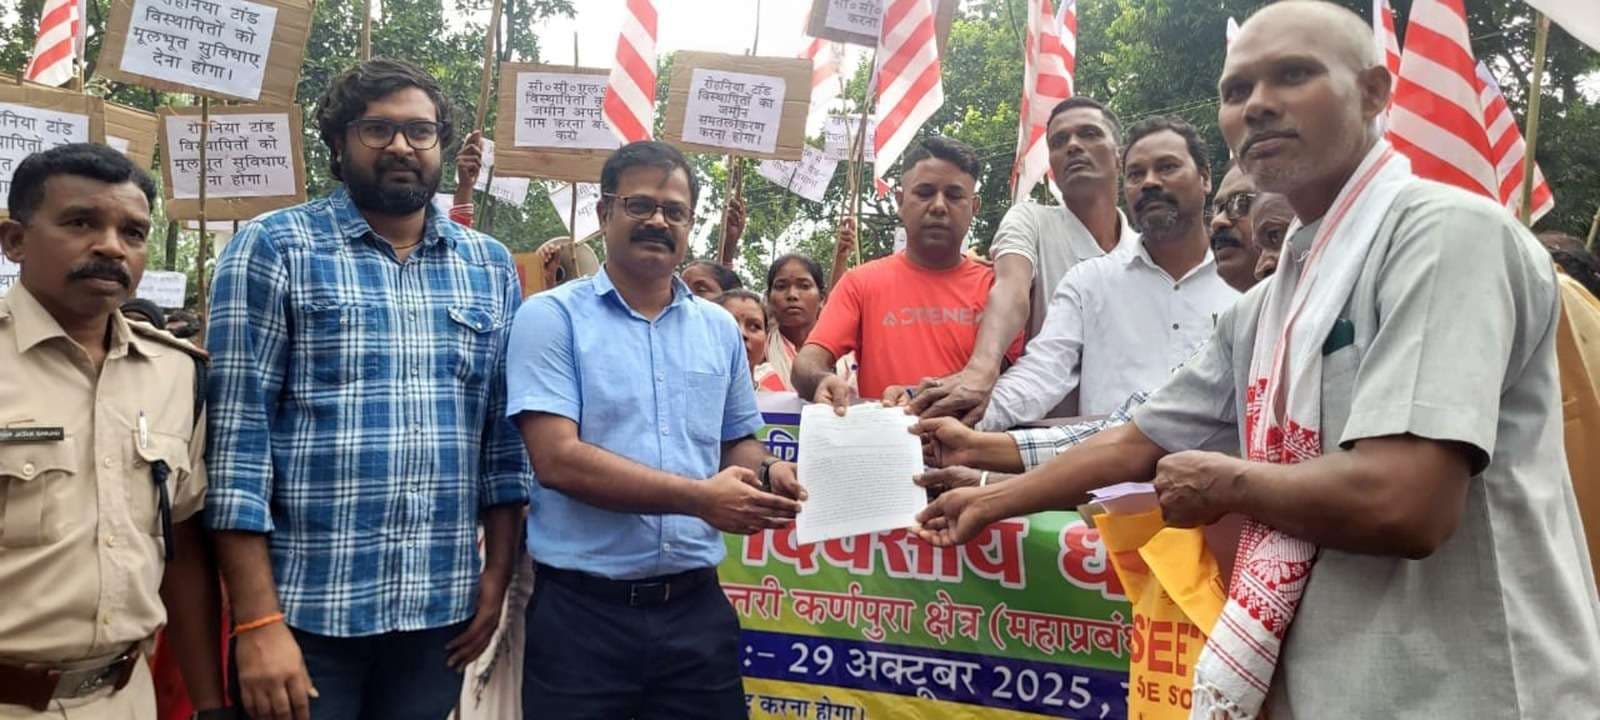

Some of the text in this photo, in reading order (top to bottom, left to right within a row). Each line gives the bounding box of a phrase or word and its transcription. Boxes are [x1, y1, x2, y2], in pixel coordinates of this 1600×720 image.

[145, 6, 256, 44] विस्थापितों को
[231, 7, 260, 24] टांड
[133, 26, 189, 50] मूलभूत
[152, 47, 182, 69] देना
[0, 110, 74, 136] निया टांड
[187, 120, 275, 134] रोनिया टांड
[525, 118, 547, 128] नाम
[257, 135, 278, 150] को
[722, 576, 786, 619] त्तरी
[790, 583, 917, 642] कर्णपुरा
[924, 590, 983, 644] क्षेत्र
[788, 642, 834, 676] 29
[846, 648, 981, 700] अक्टूबर
